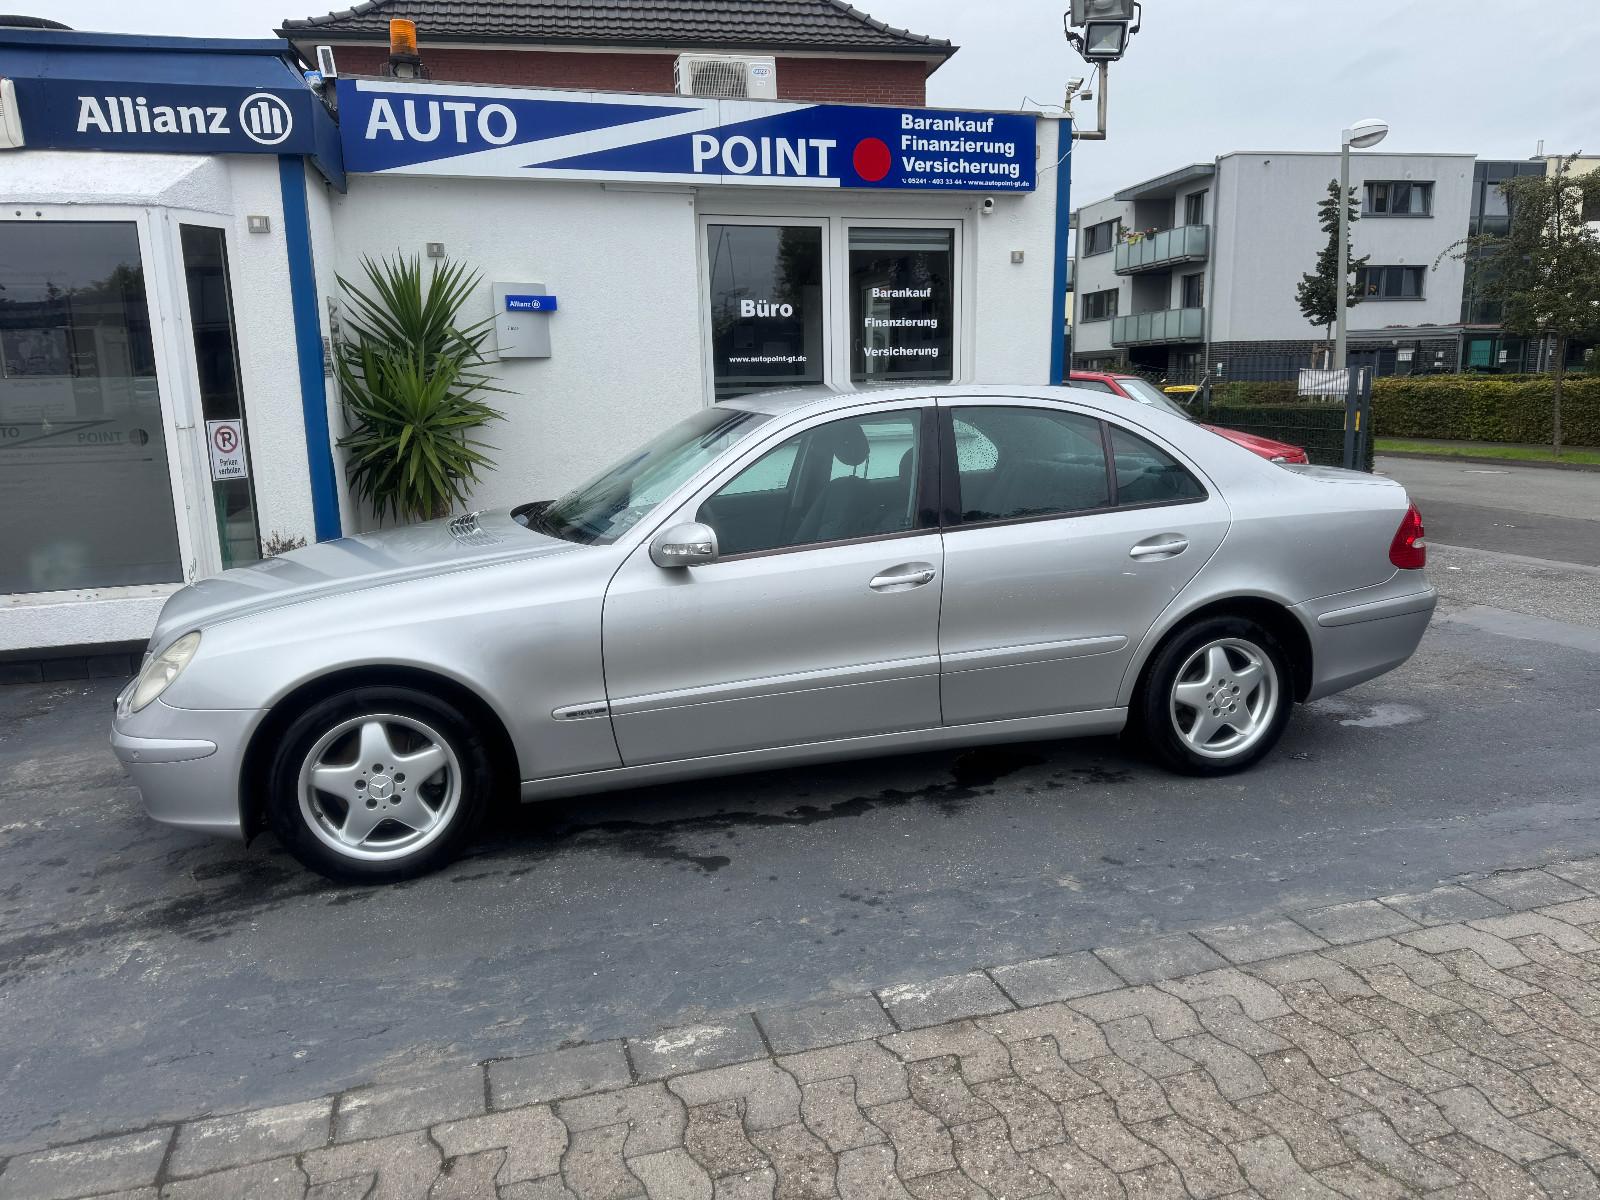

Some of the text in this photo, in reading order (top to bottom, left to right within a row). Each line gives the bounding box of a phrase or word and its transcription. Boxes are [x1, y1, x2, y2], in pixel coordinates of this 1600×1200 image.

[77, 96, 231, 134] Allianz
[365, 98, 517, 145] AUTO
[901, 113, 994, 133] Barankauf
[901, 134, 1015, 158] Finanzierung
[692, 134, 837, 177] POINT
[902, 157, 1020, 179] Versicherung
[967, 179, 1030, 187] www.autopoint-gt.de
[872, 287, 932, 298] Barankauf
[510, 300, 531, 308] Allianz
[740, 299, 793, 318] Büro
[864, 317, 938, 328] Finanzierung
[728, 355, 807, 364] www.autopoint-gt.de
[863, 346, 939, 358] Versicherung
[77, 431, 123, 443] POINT
